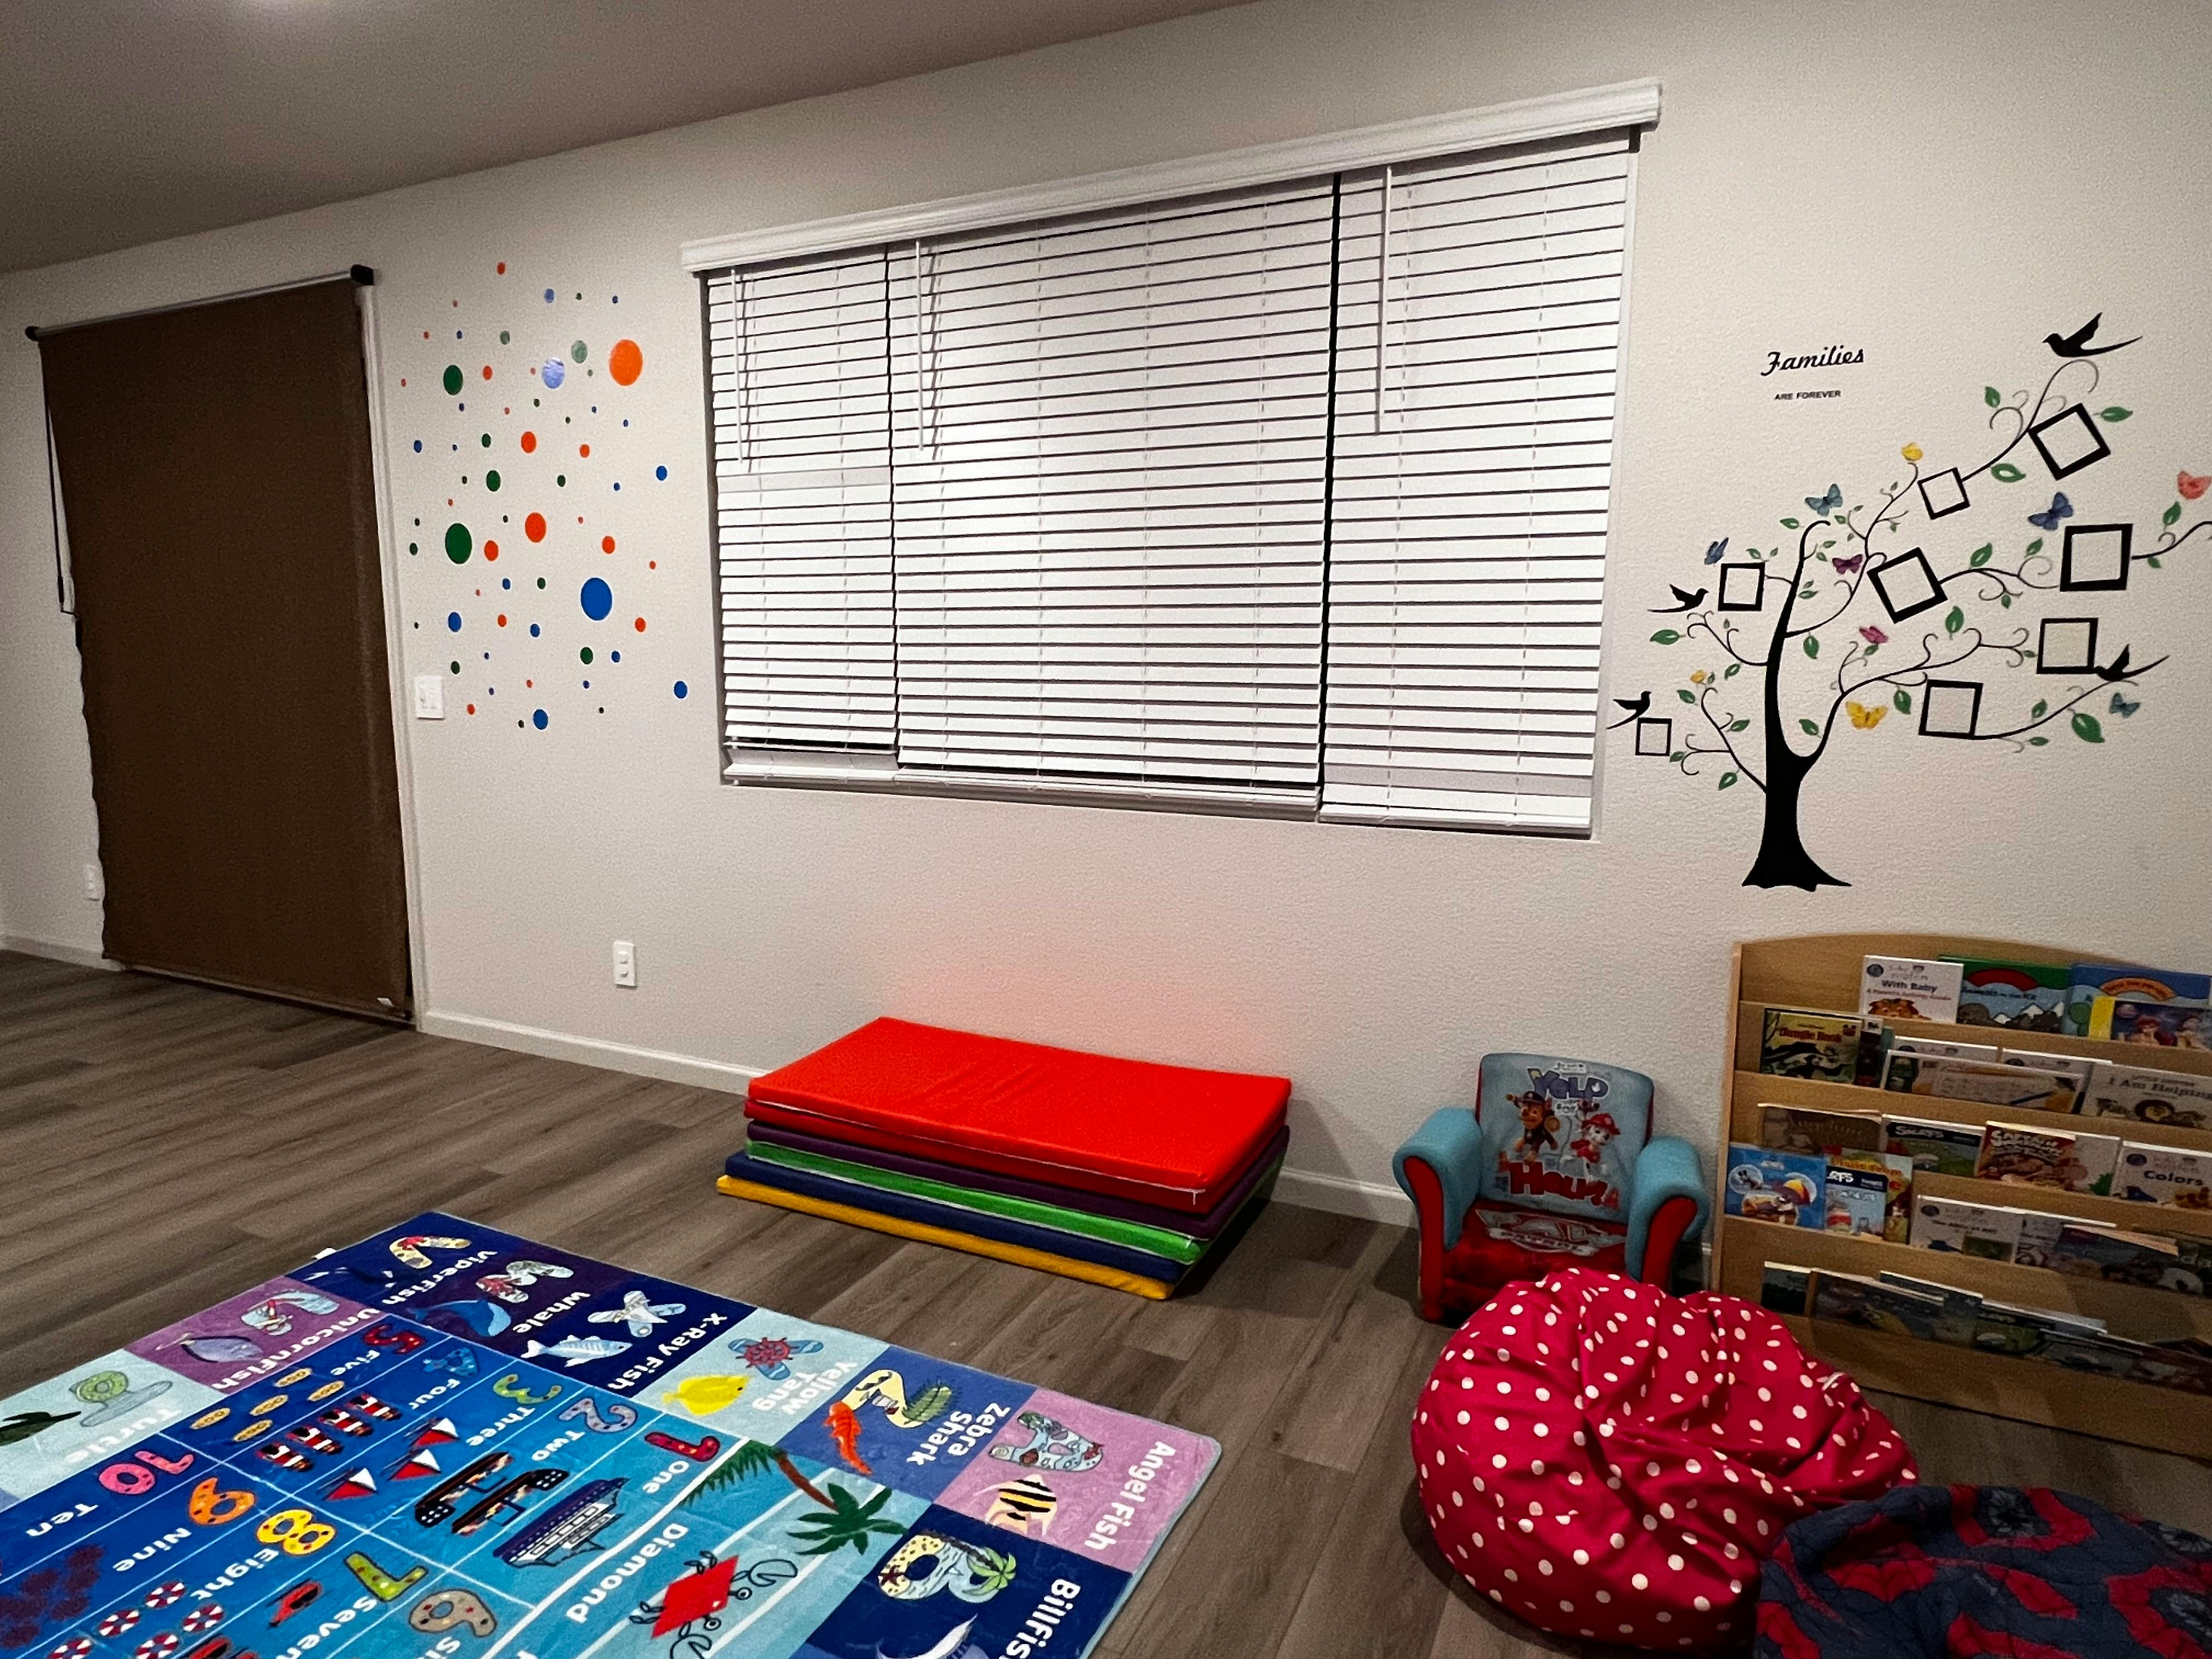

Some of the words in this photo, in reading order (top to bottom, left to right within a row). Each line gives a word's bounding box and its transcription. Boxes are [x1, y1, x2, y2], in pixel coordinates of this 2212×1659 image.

[1760, 345, 1864, 376] Families
[1797, 390, 1841, 399] FOREVER
[2144, 1170, 2203, 1186] Colors
[659, 1312, 728, 1356] X-Ray
[330, 1350, 380, 1375] Five
[607, 1356, 664, 1389] Fish
[408, 1378, 461, 1410] Four
[493, 1373, 562, 1405] 3
[751, 1372, 817, 1411] Tang
[781, 1361, 858, 1416] Yellow
[63, 1408, 182, 1464] Turtle
[465, 1406, 536, 1447] Three
[558, 1397, 638, 1434] 2
[906, 1410, 973, 1466] Shark
[947, 1402, 1011, 1457] Zebra
[531, 1430, 586, 1462] Two
[99, 1451, 194, 1496] 10
[642, 1459, 690, 1494] One
[1119, 1441, 1177, 1503] Angel
[26, 1503, 99, 1537] Ten
[189, 1476, 256, 1526] 9
[256, 1509, 337, 1556] 8
[1084, 1502, 1136, 1550] Fish
[112, 1527, 192, 1572] Nine
[190, 1548, 279, 1600] Eight
[343, 1551, 428, 1601] 7
[566, 1523, 689, 1623] Diamond
[408, 1588, 498, 1638] 6
[998, 1578, 1082, 1659] Billfis
